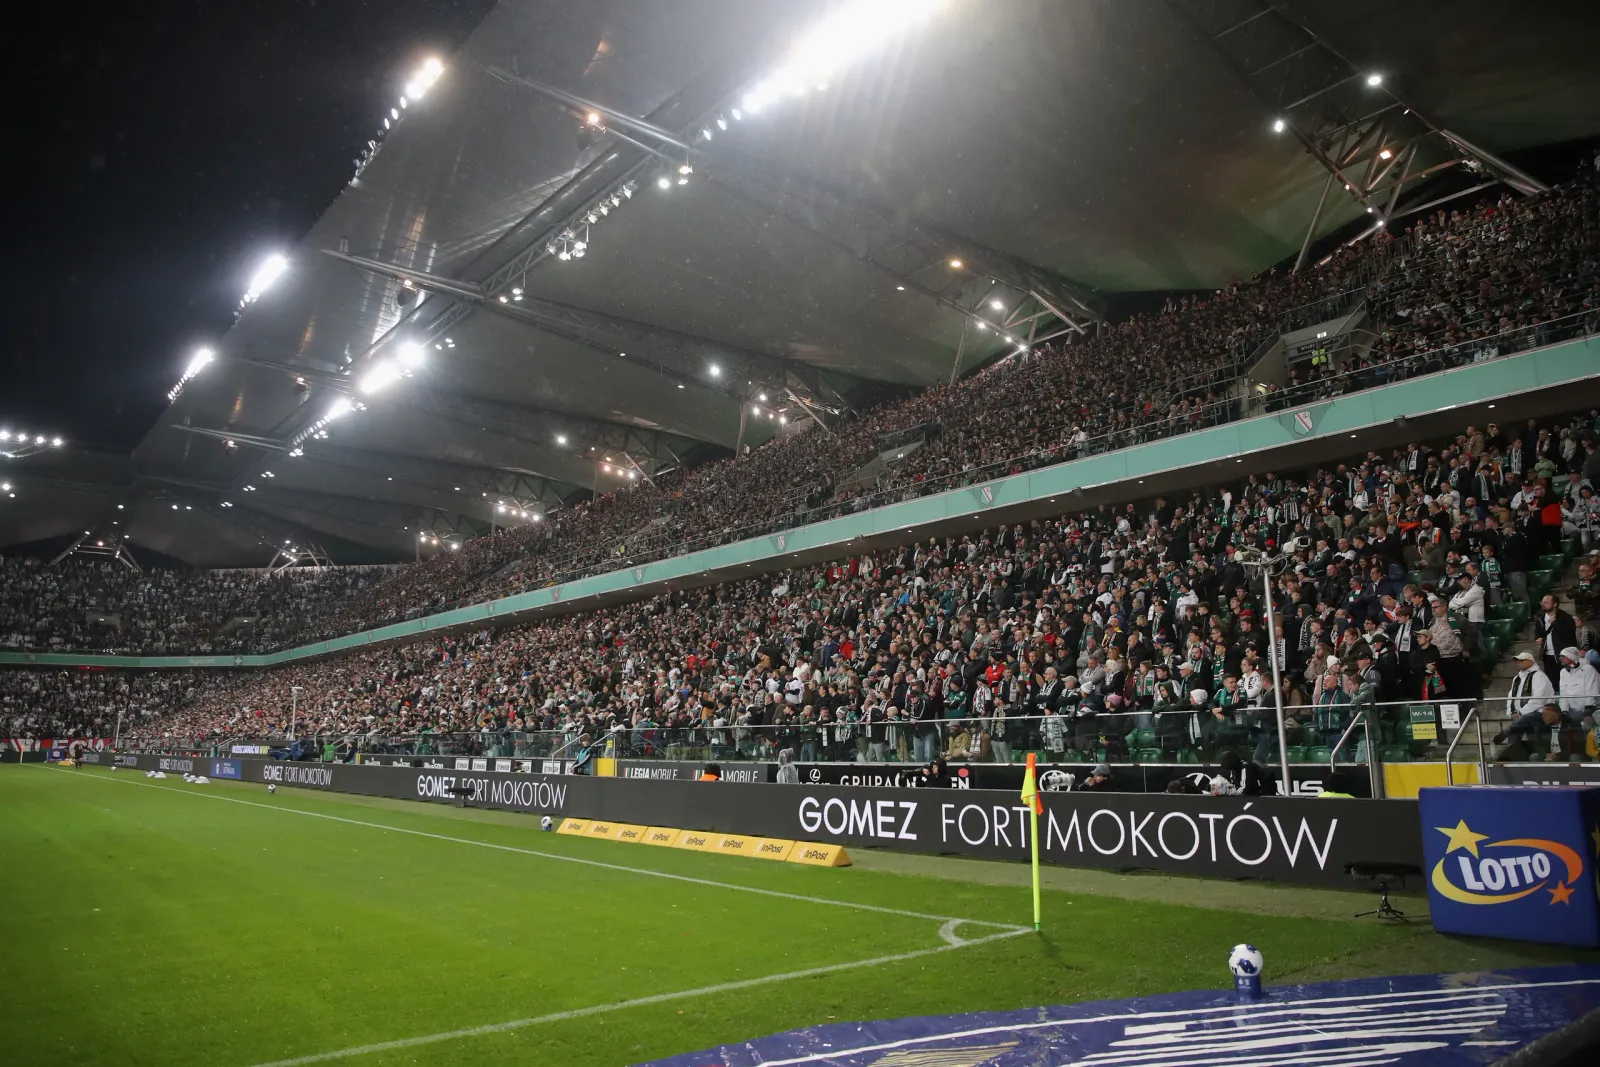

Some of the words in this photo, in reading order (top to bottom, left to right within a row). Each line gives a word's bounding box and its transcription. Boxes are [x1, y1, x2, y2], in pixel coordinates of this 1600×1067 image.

[264, 765, 283, 781] GOMEZ
[285, 766, 298, 782] FORT
[299, 765, 333, 786] MOKOTÓW
[631, 767, 650, 779] LEGIA
[417, 774, 456, 799] GOMEZ
[461, 777, 489, 802] FORT
[491, 776, 567, 810] MOKOTÓW
[594, 825, 609, 833] InPost
[621, 830, 638, 838] InPost
[799, 796, 918, 841] GOMEZ
[941, 803, 1031, 849] FORT
[1046, 802, 1338, 871] MOKOTÓW
[652, 833, 670, 841] InPost
[686, 836, 706, 846] InPost
[723, 840, 744, 849] InPost
[761, 843, 784, 854] InPost
[804, 850, 829, 861] InPost
[1457, 852, 1551, 892] LOTTO
